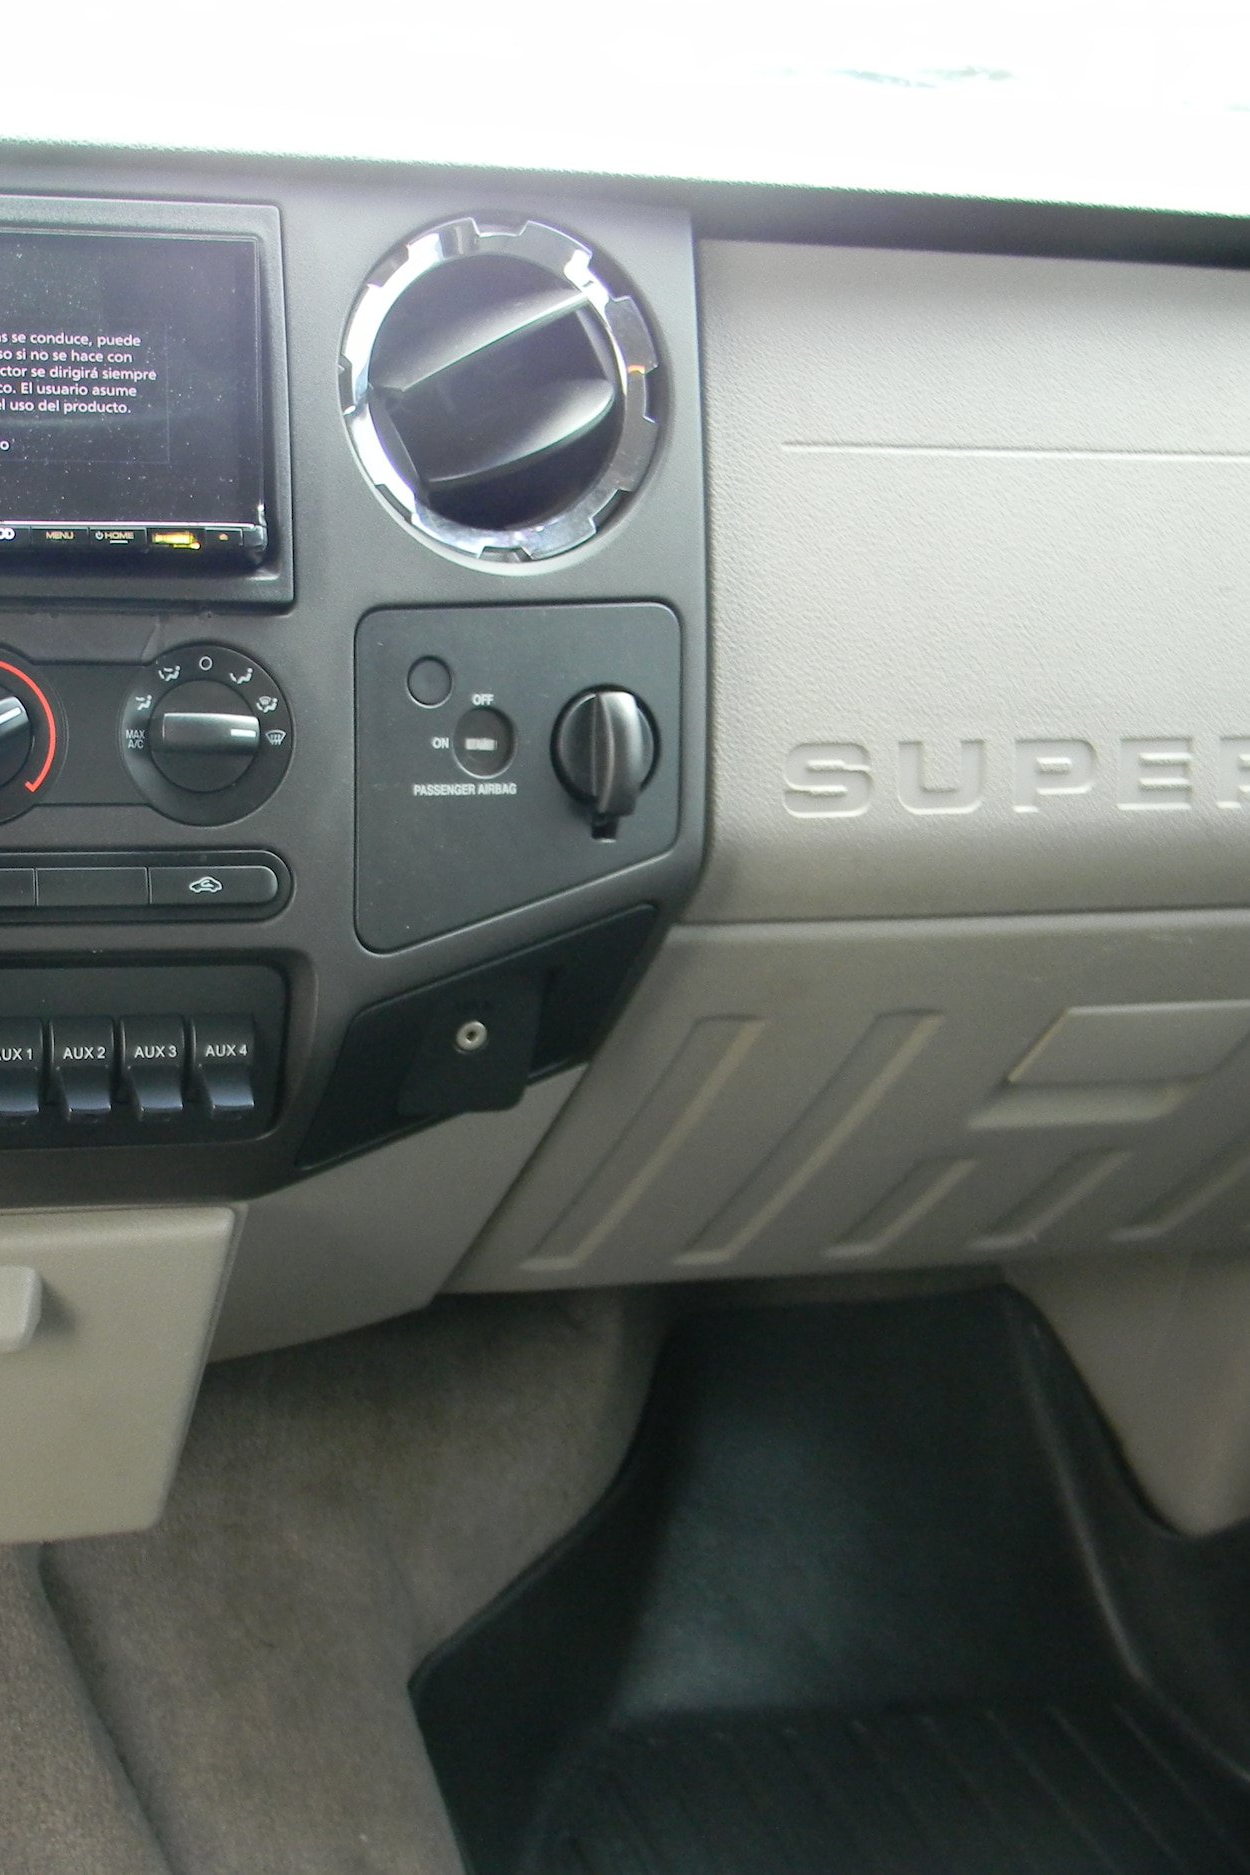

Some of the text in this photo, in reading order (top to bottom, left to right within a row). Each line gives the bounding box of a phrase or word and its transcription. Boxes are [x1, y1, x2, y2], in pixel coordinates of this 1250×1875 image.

[12, 332, 26, 344] se
[30, 332, 93, 347] conduce,
[97, 334, 142, 349] puede
[16, 348, 27, 361] si
[30, 350, 49, 361] no
[52, 351, 67, 362] se
[71, 349, 103, 363] hace
[107, 352, 133, 363] con
[31, 367, 46, 378] se
[49, 365, 99, 381] dirigirá
[102, 368, 158, 383] siempre
[20, 382, 34, 395] El
[36, 382, 89, 396] usuario
[91, 386, 137, 397] asume
[9, 401, 35, 412] uso
[38, 400, 60, 412] del
[63, 400, 132, 415] producto.
[45, 531, 74, 540] MENU
[104, 531, 135, 540] HOME
[472, 693, 495, 706] OFF
[125, 729, 146, 740] MAX
[128, 739, 145, 749] A/C
[431, 737, 450, 749] ON
[413, 783, 518, 796] PASSENGER AIRBAG
[27, 1047, 34, 1060] 1
[62, 1047, 106, 1060] AUX 2
[134, 1046, 178, 1059] AUX 3
[205, 1044, 248, 1057] AUX 4
